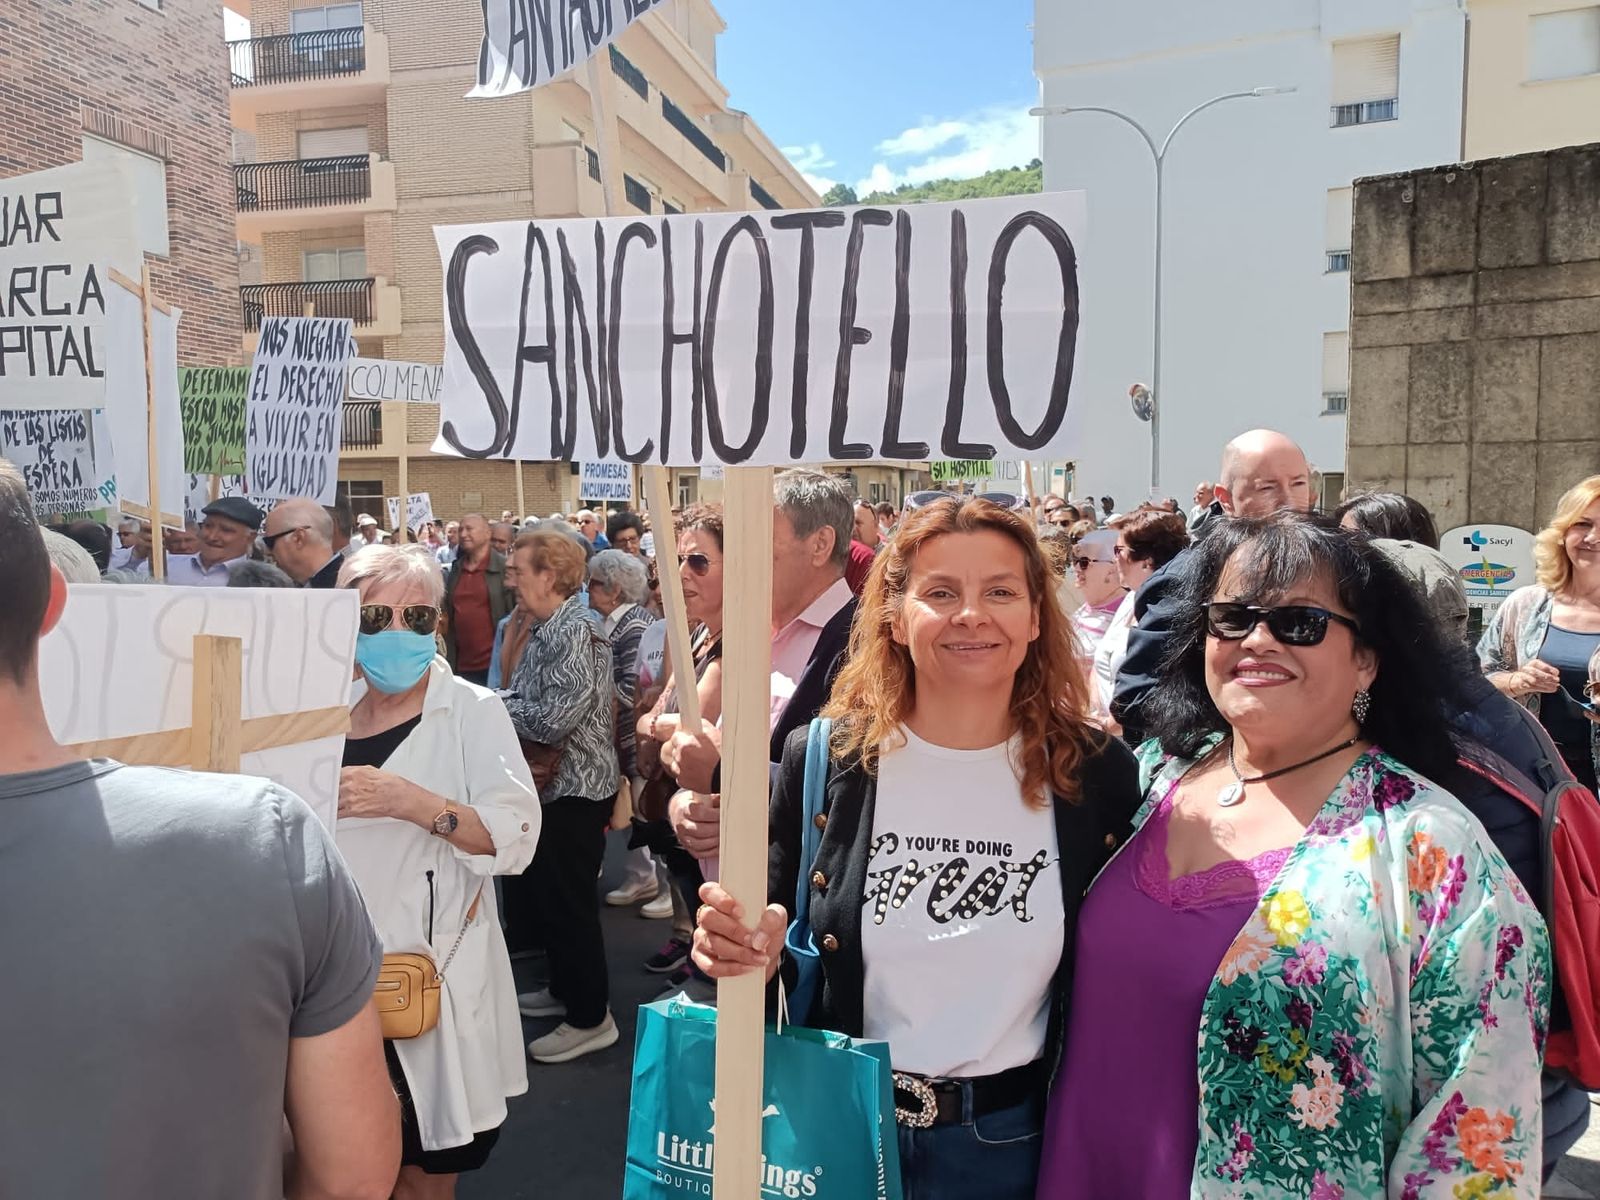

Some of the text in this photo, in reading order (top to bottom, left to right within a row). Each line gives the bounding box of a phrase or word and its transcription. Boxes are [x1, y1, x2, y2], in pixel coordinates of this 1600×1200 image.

[0, 264, 105, 317] RCA
[258, 318, 290, 358] NOS
[292, 319, 349, 363] NIEGAN
[442, 209, 1080, 464] SANCHOTELLO
[182, 368, 252, 395] DEFENDAM
[252, 364, 343, 410] EL DERECHO
[180, 397, 217, 424] ESTRO
[4, 414, 86, 448] DE LAS LISTAS
[249, 408, 336, 454] A VIVIR EN
[38, 441, 55, 464] DE
[23, 457, 83, 491] ESPERA
[251, 451, 328, 498] IGUALDAD
[584, 462, 628, 480] PROMESAS
[581, 482, 632, 499] INCUMPLIDAS
[1489, 537, 1513, 547] Sacyl
[905, 836, 1013, 857] YOU'RE DOING
[657, 1131, 714, 1170] Littl
[656, 1169, 713, 1196] BOUTIQ
